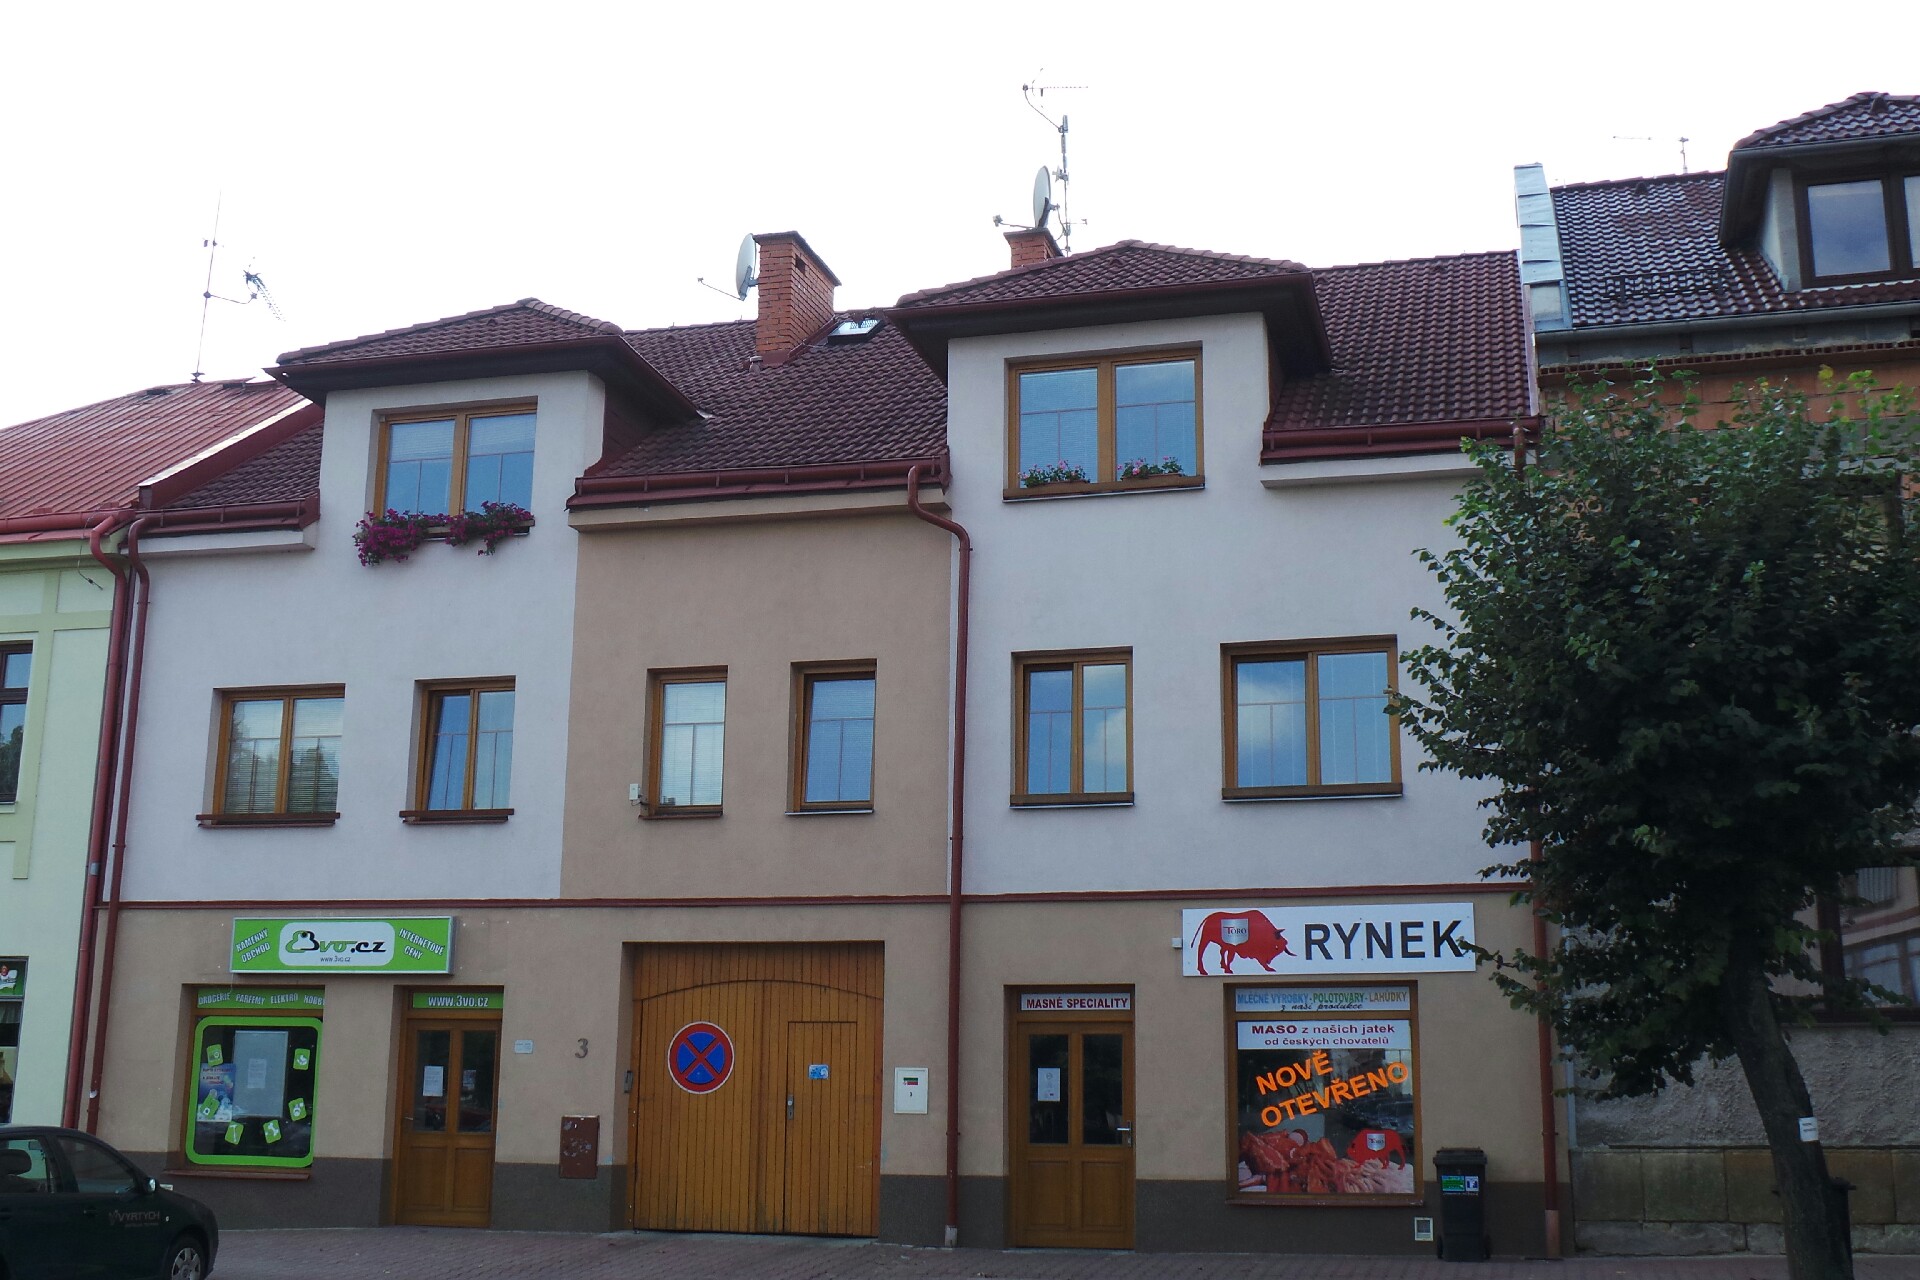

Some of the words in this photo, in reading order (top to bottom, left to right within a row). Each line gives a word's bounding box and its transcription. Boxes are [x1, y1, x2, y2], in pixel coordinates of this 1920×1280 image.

[1304, 920, 1464, 960] RYNEK
[241, 942, 270, 963] OBCHOD
[404, 945, 423, 960] CENY
[198, 992, 231, 1005] DROGERIE
[270, 992, 298, 1005] ELEKTRO
[428, 994, 489, 1007] www.3vo.cz
[1026, 997, 1063, 1009] MASNÉ
[1067, 998, 1128, 1009] SPECIALITY
[1313, 992, 1365, 1003] POLOTOVARY
[1252, 1025, 1297, 1034] MASO
[1302, 1026, 1309, 1034] z
[1313, 1024, 1358, 1034] našich
[1361, 1024, 1395, 1036] jatek
[574, 1038, 589, 1059] 3
[1265, 1037, 1279, 1046] od
[1283, 1037, 1329, 1047] českých
[1333, 1036, 1389, 1045] chovatelů
[1256, 1049, 1333, 1096] NOVĚ
[1261, 1061, 1408, 1127] OTEVŘENO
